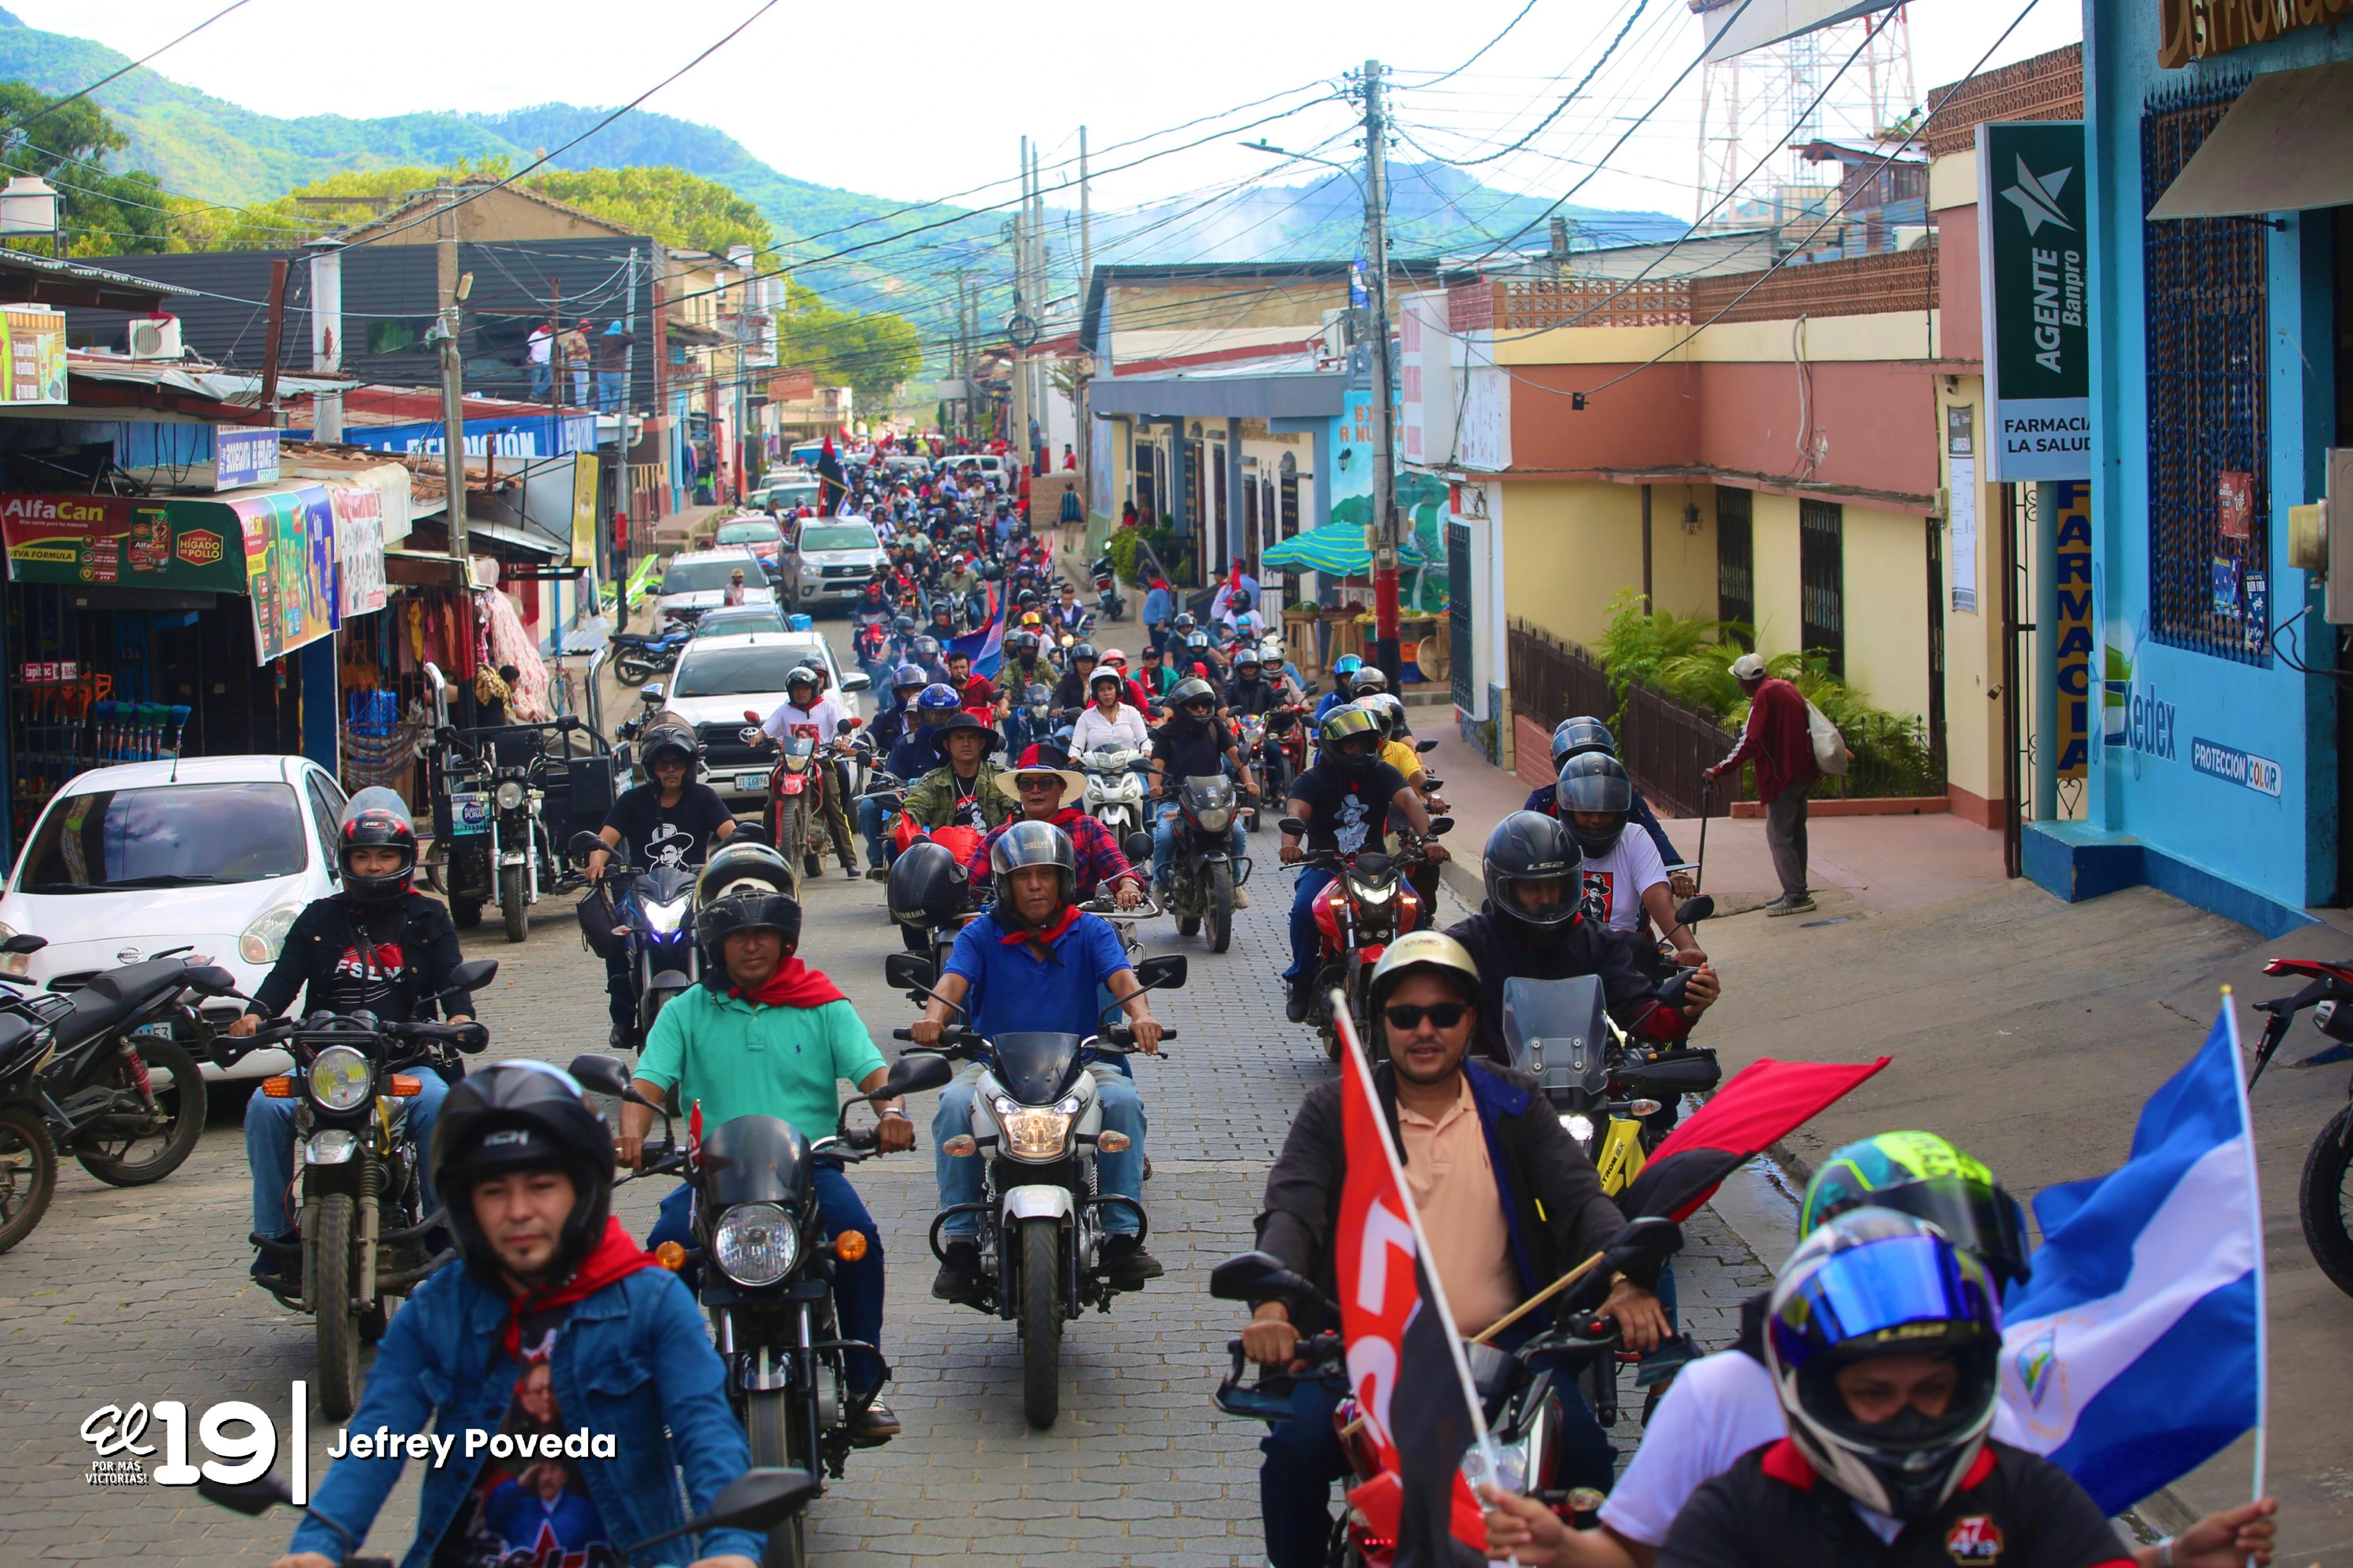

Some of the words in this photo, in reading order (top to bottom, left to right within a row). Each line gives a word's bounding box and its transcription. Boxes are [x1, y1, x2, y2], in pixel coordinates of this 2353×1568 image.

[2062, 250, 2084, 327] Banpro
[2032, 247, 2061, 374] AGENTE
[2005, 417, 2091, 433] FARMACI
[2008, 439, 2031, 453] LA
[5, 499, 104, 521] AlfaCan
[180, 539, 220, 550] HÍGADO
[32, 550, 72, 560] FÓRMULA
[188, 549, 219, 558] POLLO
[2194, 742, 2246, 781] PROTECCIÓN
[2247, 760, 2277, 791] COLOR
[1527, 861, 1565, 871] LS2
